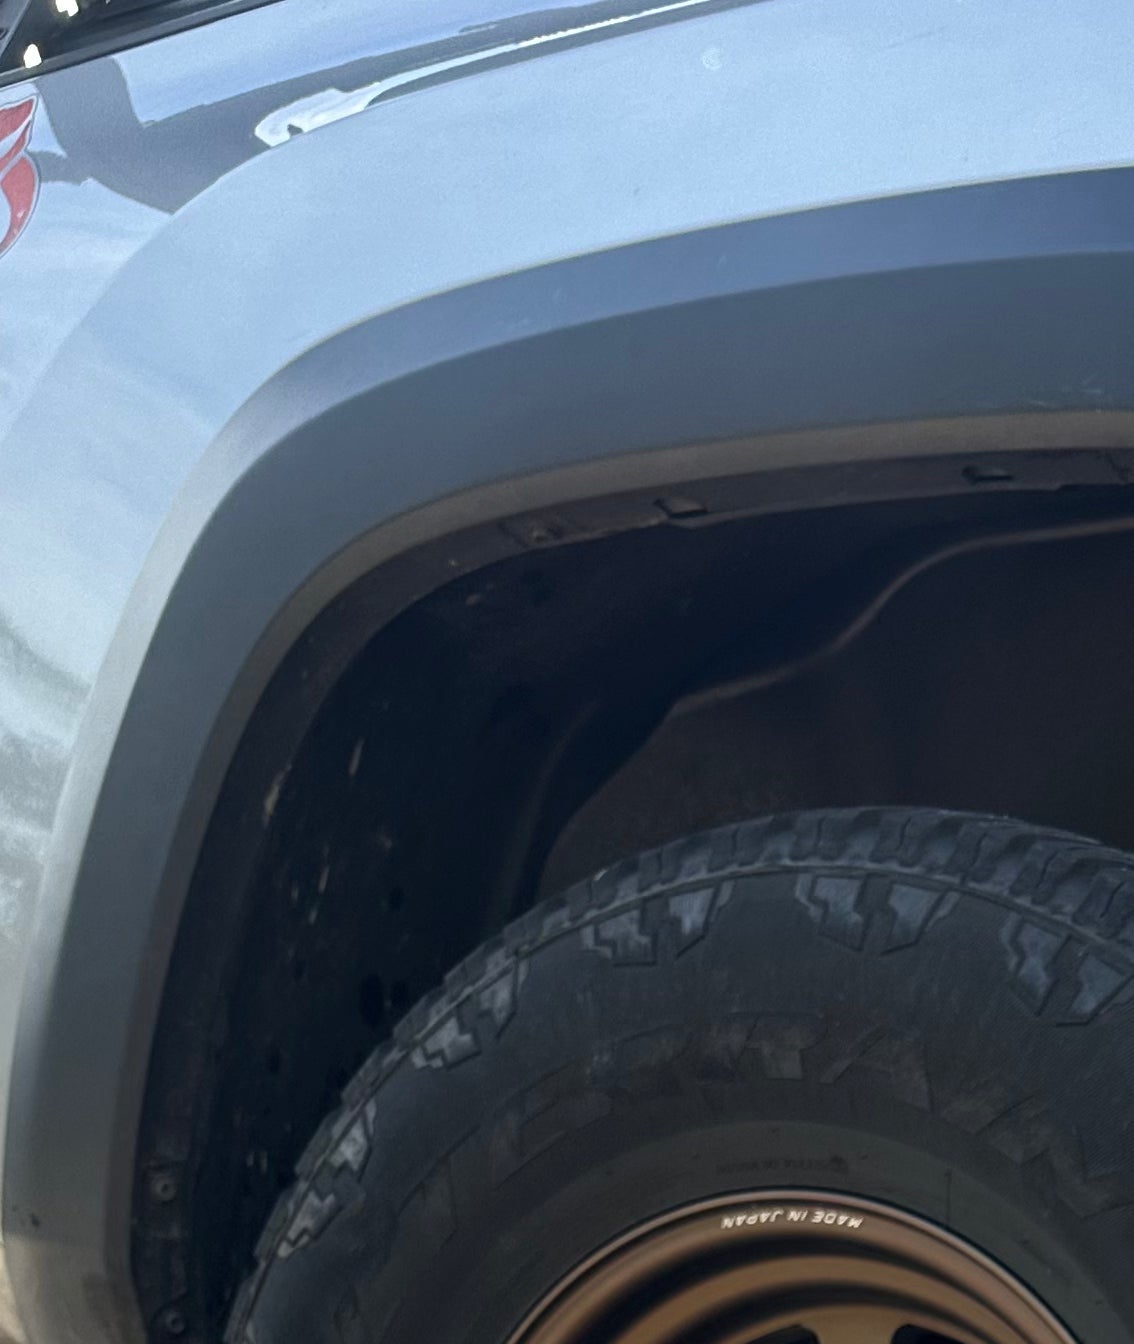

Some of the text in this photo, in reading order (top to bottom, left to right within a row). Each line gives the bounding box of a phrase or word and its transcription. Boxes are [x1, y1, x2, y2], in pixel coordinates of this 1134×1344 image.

[720, 1208, 864, 1230] MADE IN JAPAN
